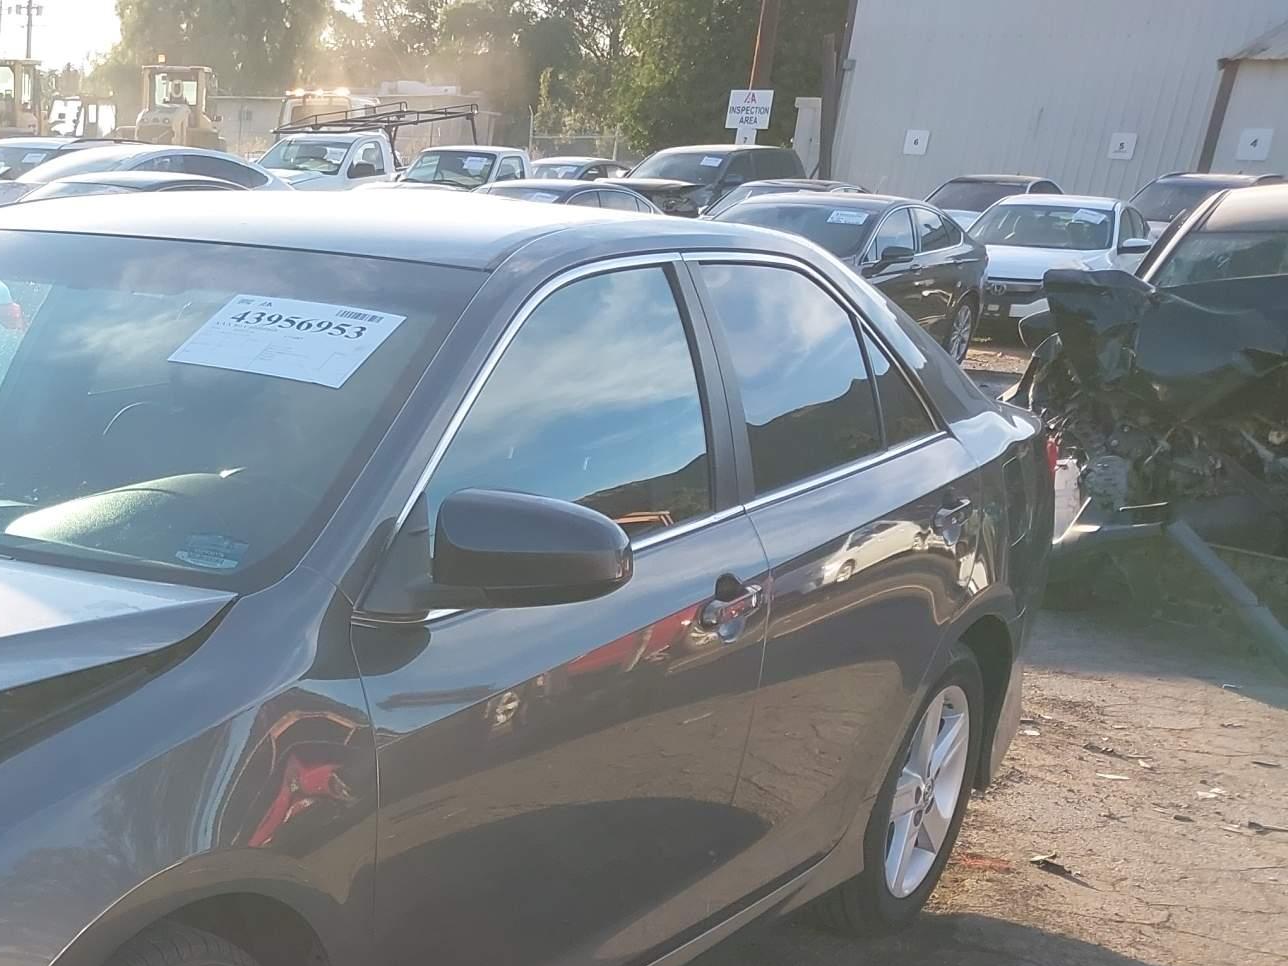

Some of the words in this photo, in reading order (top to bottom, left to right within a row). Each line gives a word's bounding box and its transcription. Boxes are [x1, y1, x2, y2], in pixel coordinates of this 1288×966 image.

[728, 106, 769, 115] INSPECTION
[739, 116, 758, 125] AREA
[913, 138, 919, 146] 6
[1119, 142, 1125, 150] 5
[1249, 138, 1259, 149] 4
[230, 310, 367, 340] 43956953
